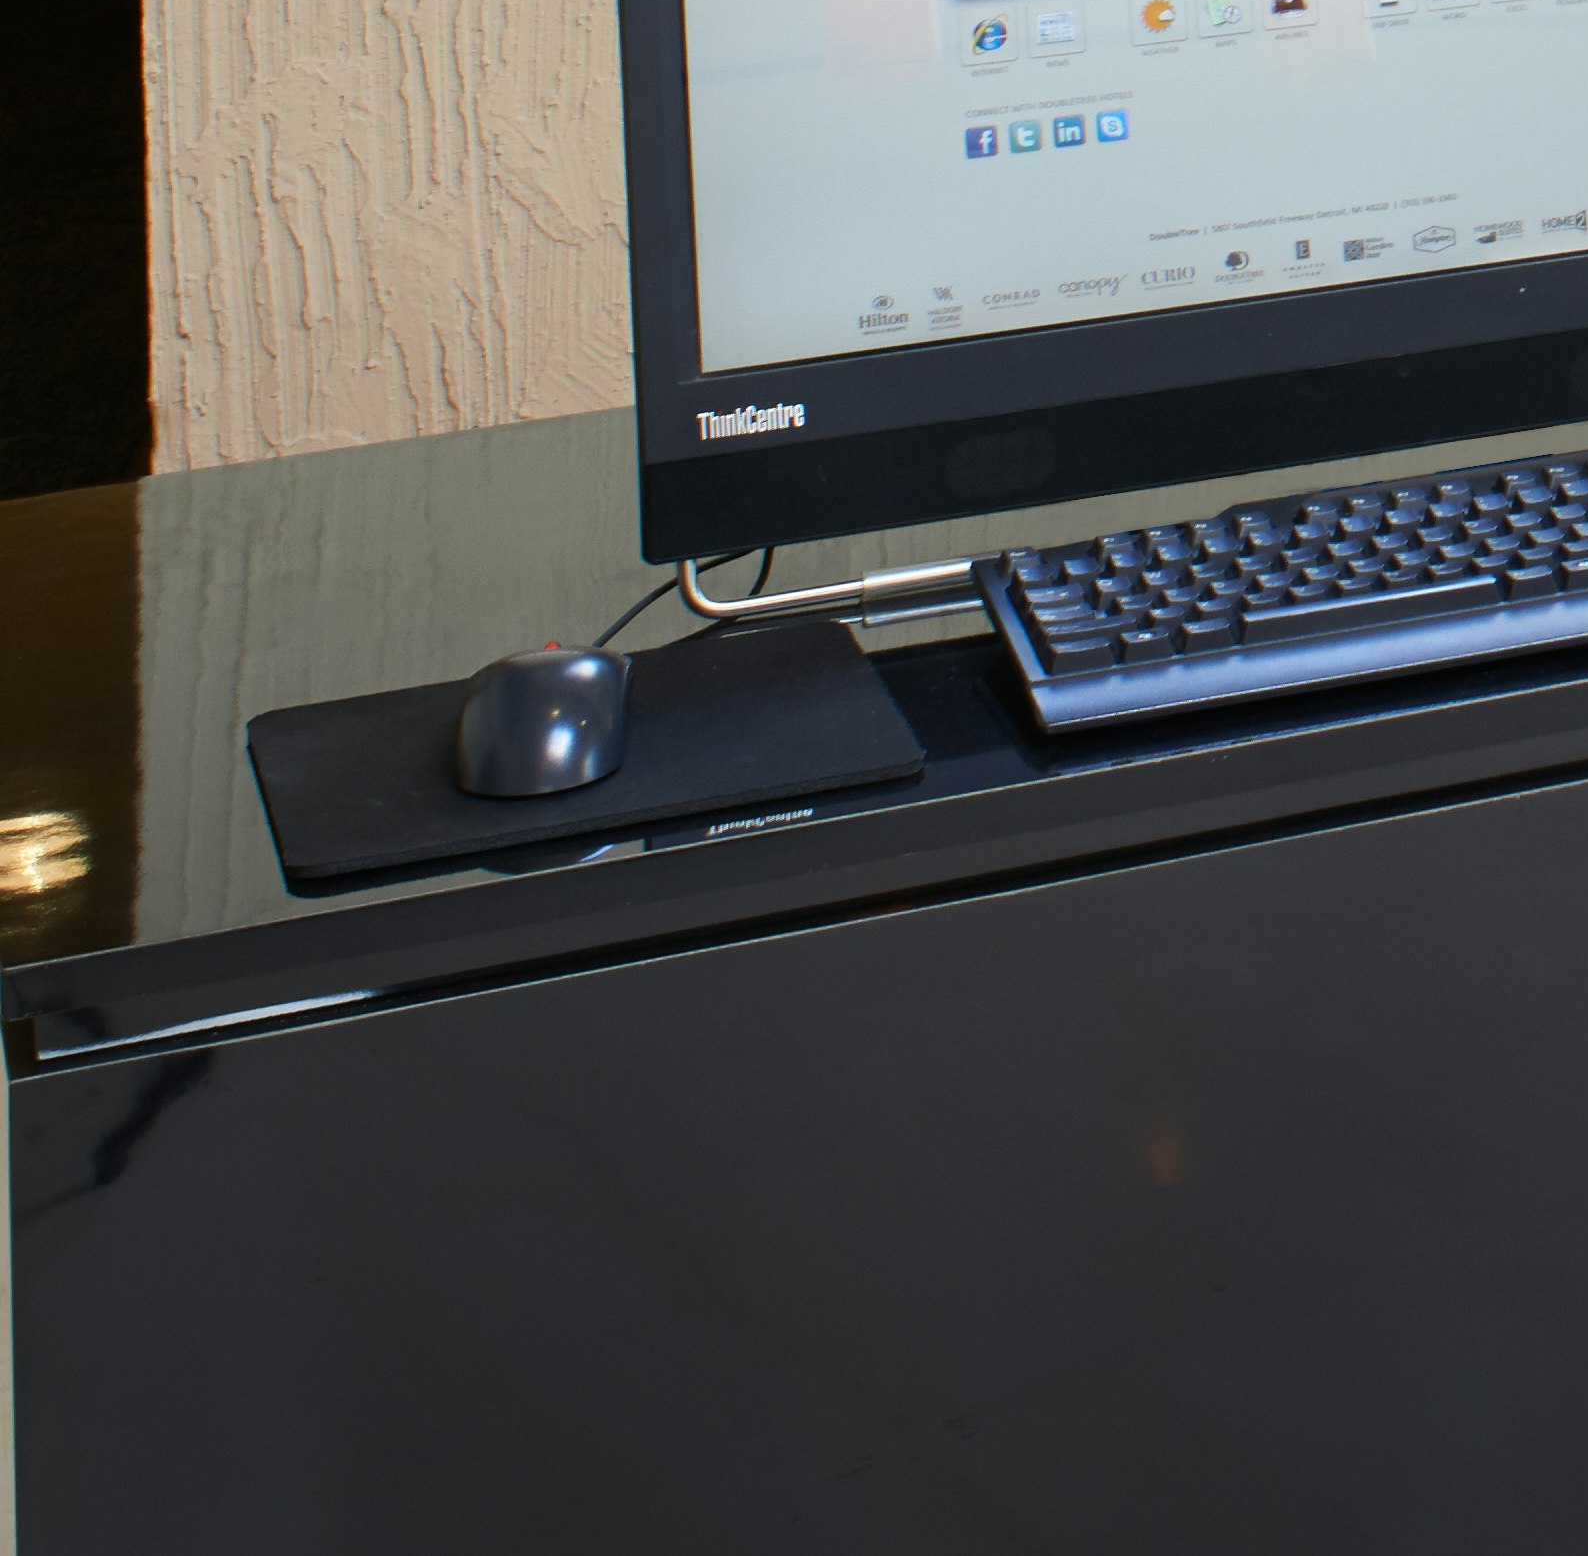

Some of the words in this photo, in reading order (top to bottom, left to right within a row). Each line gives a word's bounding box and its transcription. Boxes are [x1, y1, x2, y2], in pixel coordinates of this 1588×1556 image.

[1142, 267, 1195, 286] CURIO
[859, 312, 909, 328] Hilton
[696, 403, 805, 440] ThinkCentre
